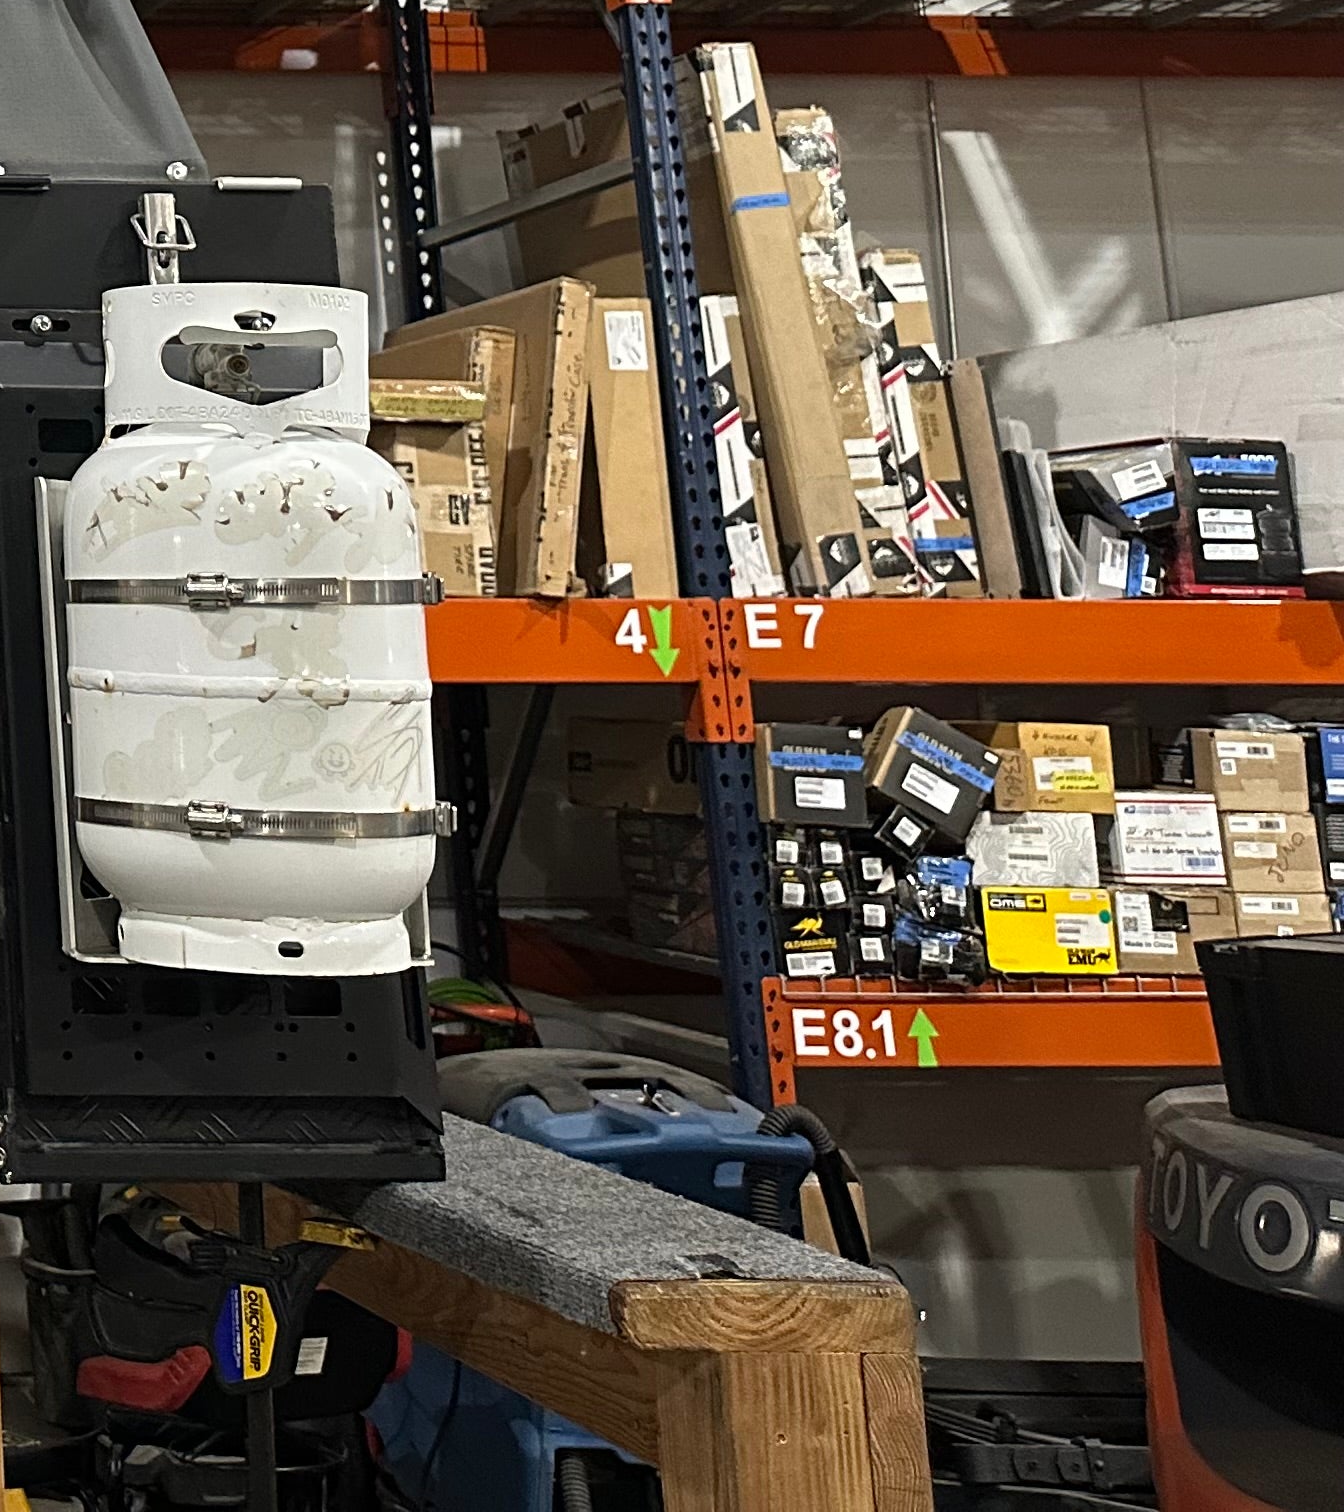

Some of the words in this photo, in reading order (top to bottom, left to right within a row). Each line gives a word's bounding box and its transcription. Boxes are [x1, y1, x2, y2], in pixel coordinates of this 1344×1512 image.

[614, 608, 646, 654] 4
[744, 604, 782, 649] E
[793, 604, 824, 649] 7
[1068, 953, 1096, 965] EMU
[1124, 940, 1143, 948] Made
[1145, 940, 1152, 948] in
[1153, 940, 1174, 950] China
[791, 1008, 897, 1059] E8.1
